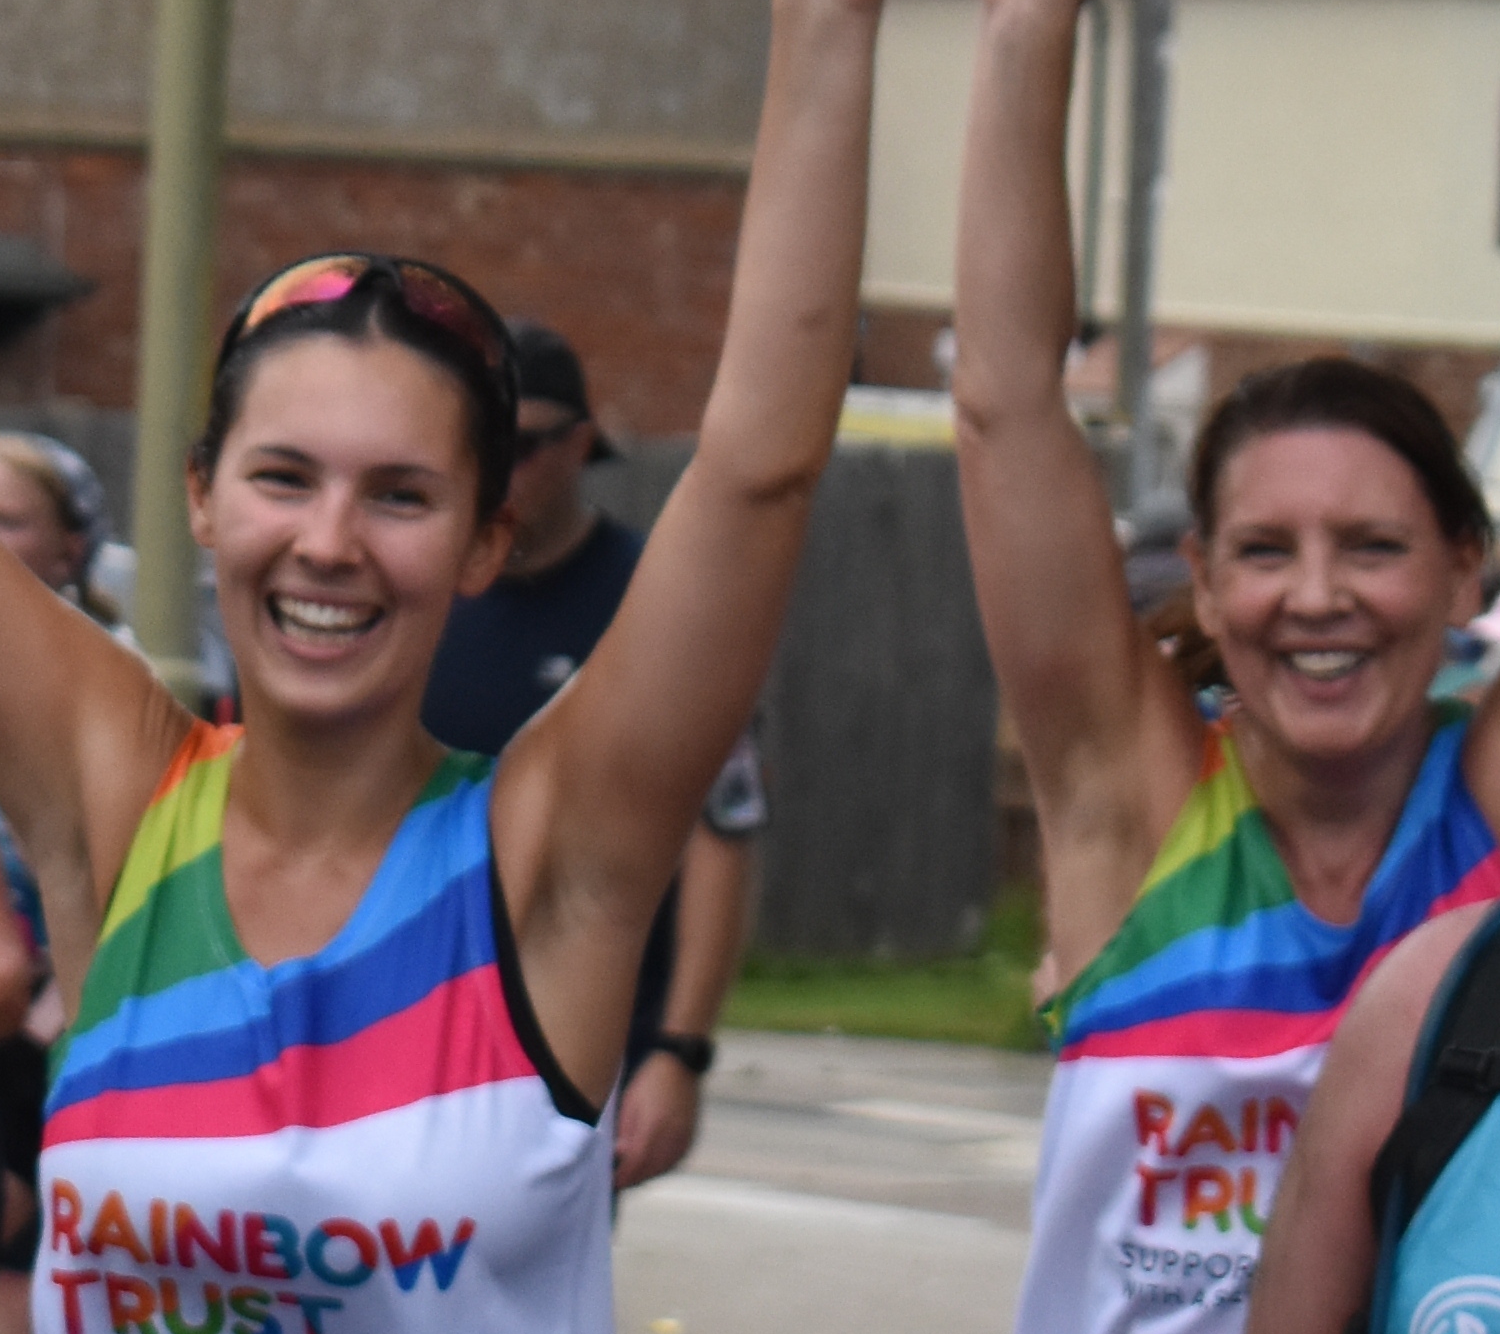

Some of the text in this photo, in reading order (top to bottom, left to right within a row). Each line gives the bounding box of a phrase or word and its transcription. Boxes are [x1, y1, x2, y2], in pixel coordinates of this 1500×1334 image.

[1134, 1089, 1298, 1156] RAIN
[1136, 1161, 1267, 1236] TRU
[52, 1177, 477, 1294] RAINBOW
[1119, 1241, 1256, 1279] SUPPOR
